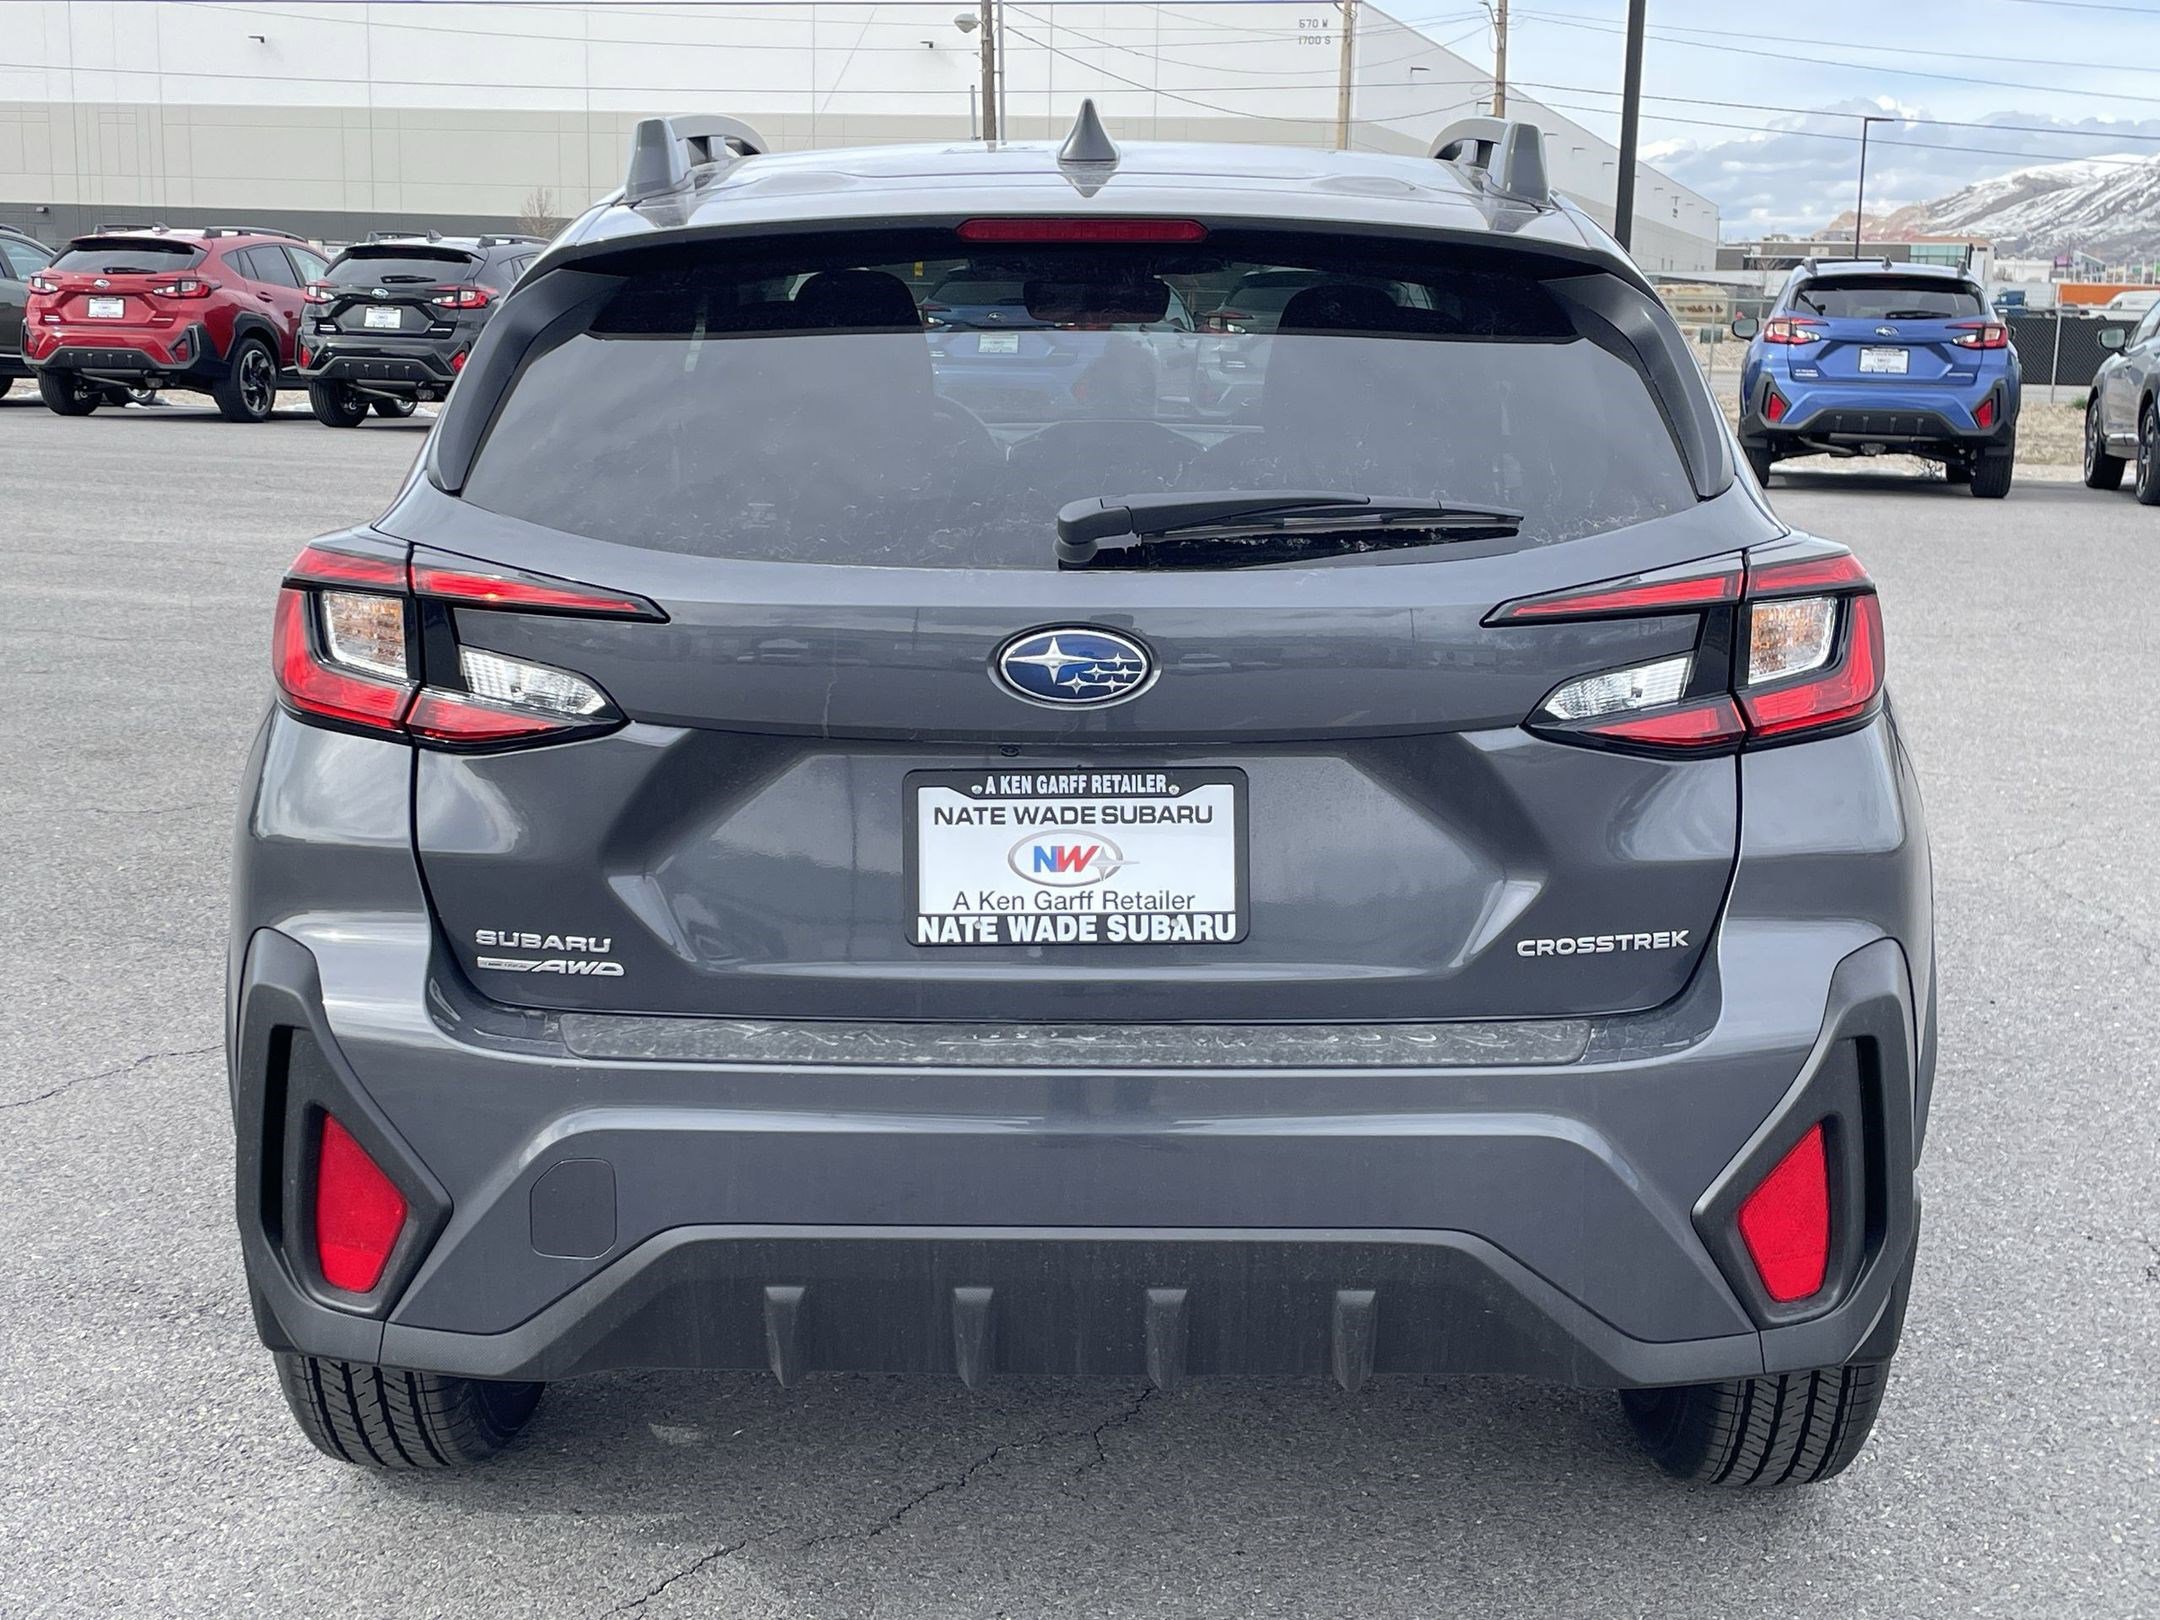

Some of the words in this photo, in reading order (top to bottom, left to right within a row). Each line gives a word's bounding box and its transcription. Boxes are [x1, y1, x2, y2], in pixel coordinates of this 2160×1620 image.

[1322, 19, 1328, 28] W
[1299, 36, 1321, 45] 1700
[1325, 35, 1331, 45] S
[985, 776, 996, 794] A
[1000, 776, 1032, 794] KEN
[1037, 775, 1087, 794] GARFF
[1092, 774, 1166, 794] RETAILER
[934, 807, 1006, 825] NATE
[1013, 806, 1095, 824] WADE
[1102, 805, 1213, 824] SUBARU
[1034, 846, 1099, 873] NW
[953, 892, 970, 911] A
[979, 891, 1024, 911] Ken
[1034, 891, 1093, 910] Garff
[1103, 891, 1195, 910] Retailer
[918, 916, 998, 943] NATE
[1007, 915, 1097, 942] WADE
[1107, 914, 1236, 942] SUBARU
[475, 929, 612, 953] SUBARU
[1517, 930, 1690, 957] CROSSTREK
[531, 959, 625, 977] AWD
